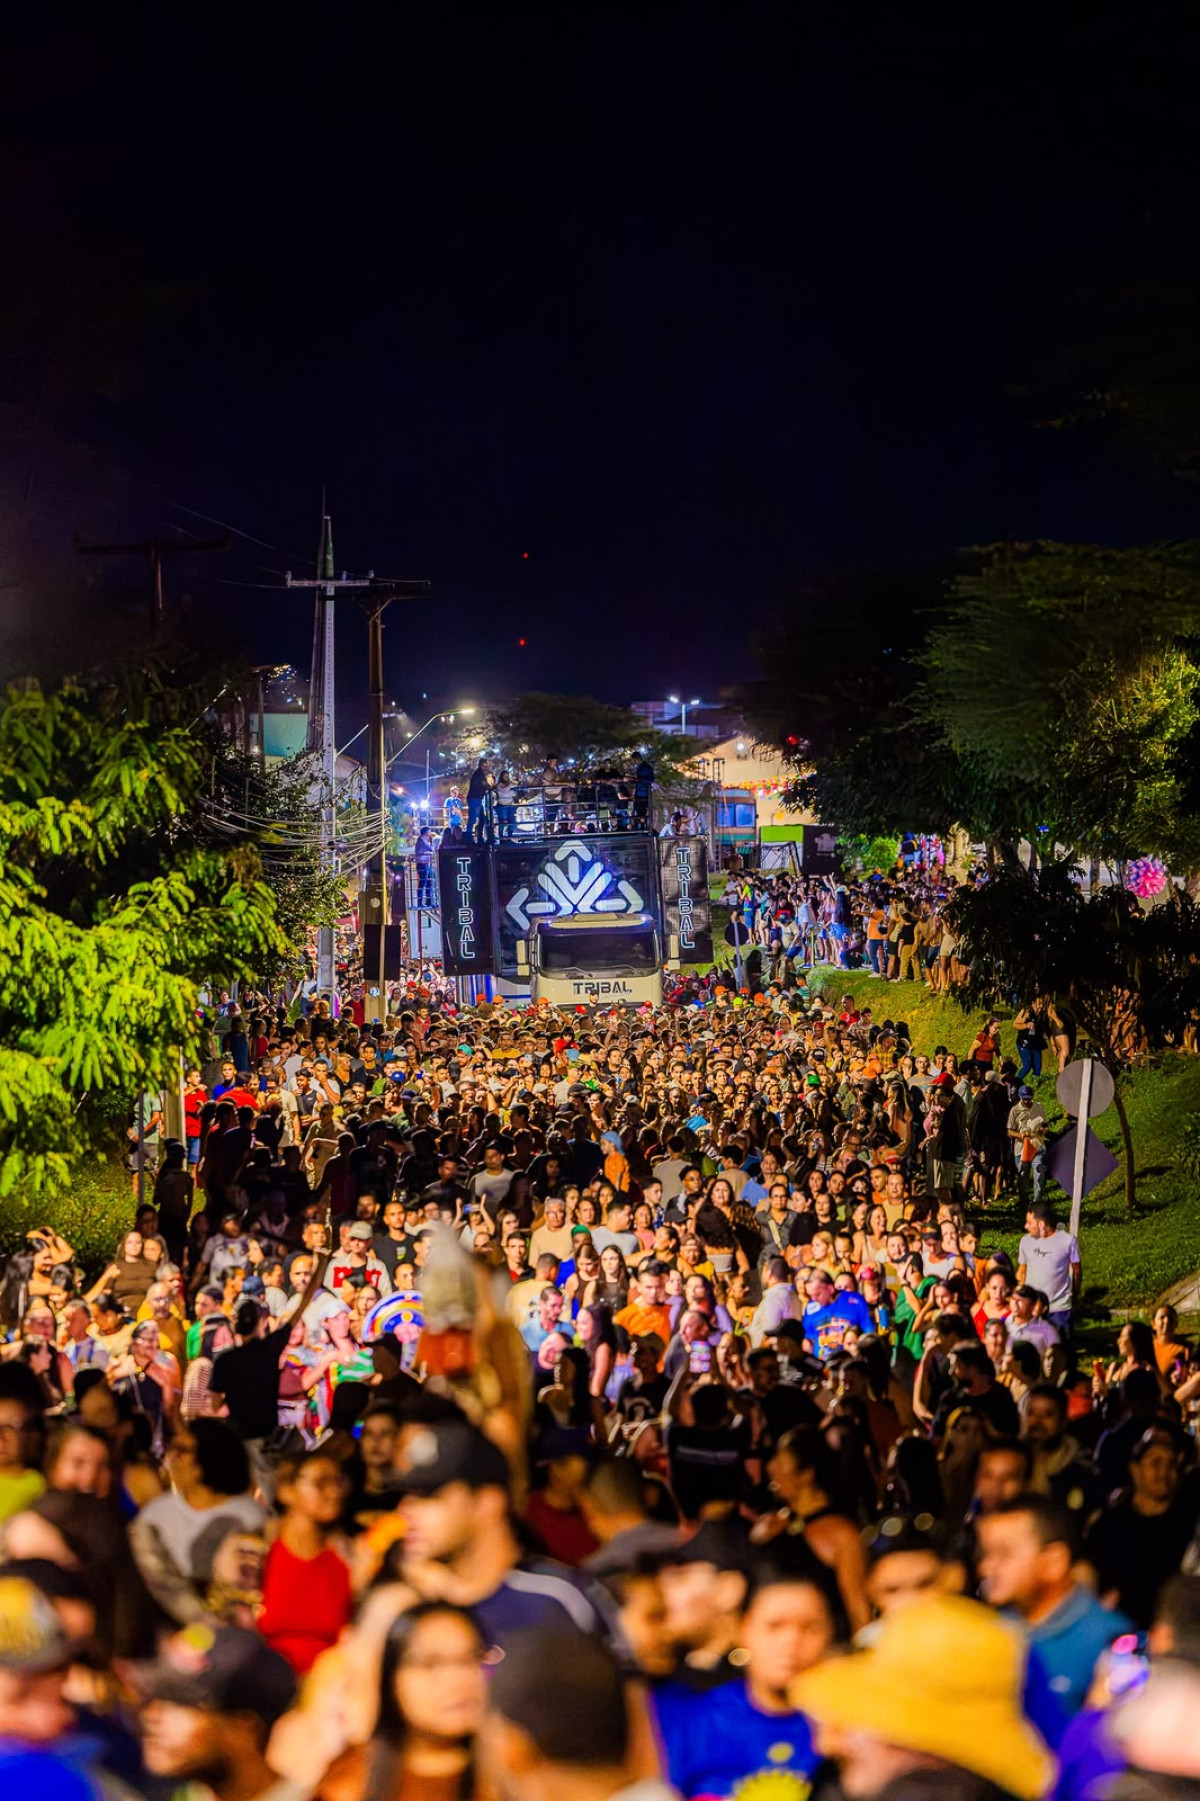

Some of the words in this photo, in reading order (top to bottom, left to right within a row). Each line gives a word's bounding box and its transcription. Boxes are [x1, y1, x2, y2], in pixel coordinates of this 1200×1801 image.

[457, 857, 475, 959] TRIBAL
[677, 847, 695, 949] TRIBAL
[573, 981, 633, 995] TRIBAL
